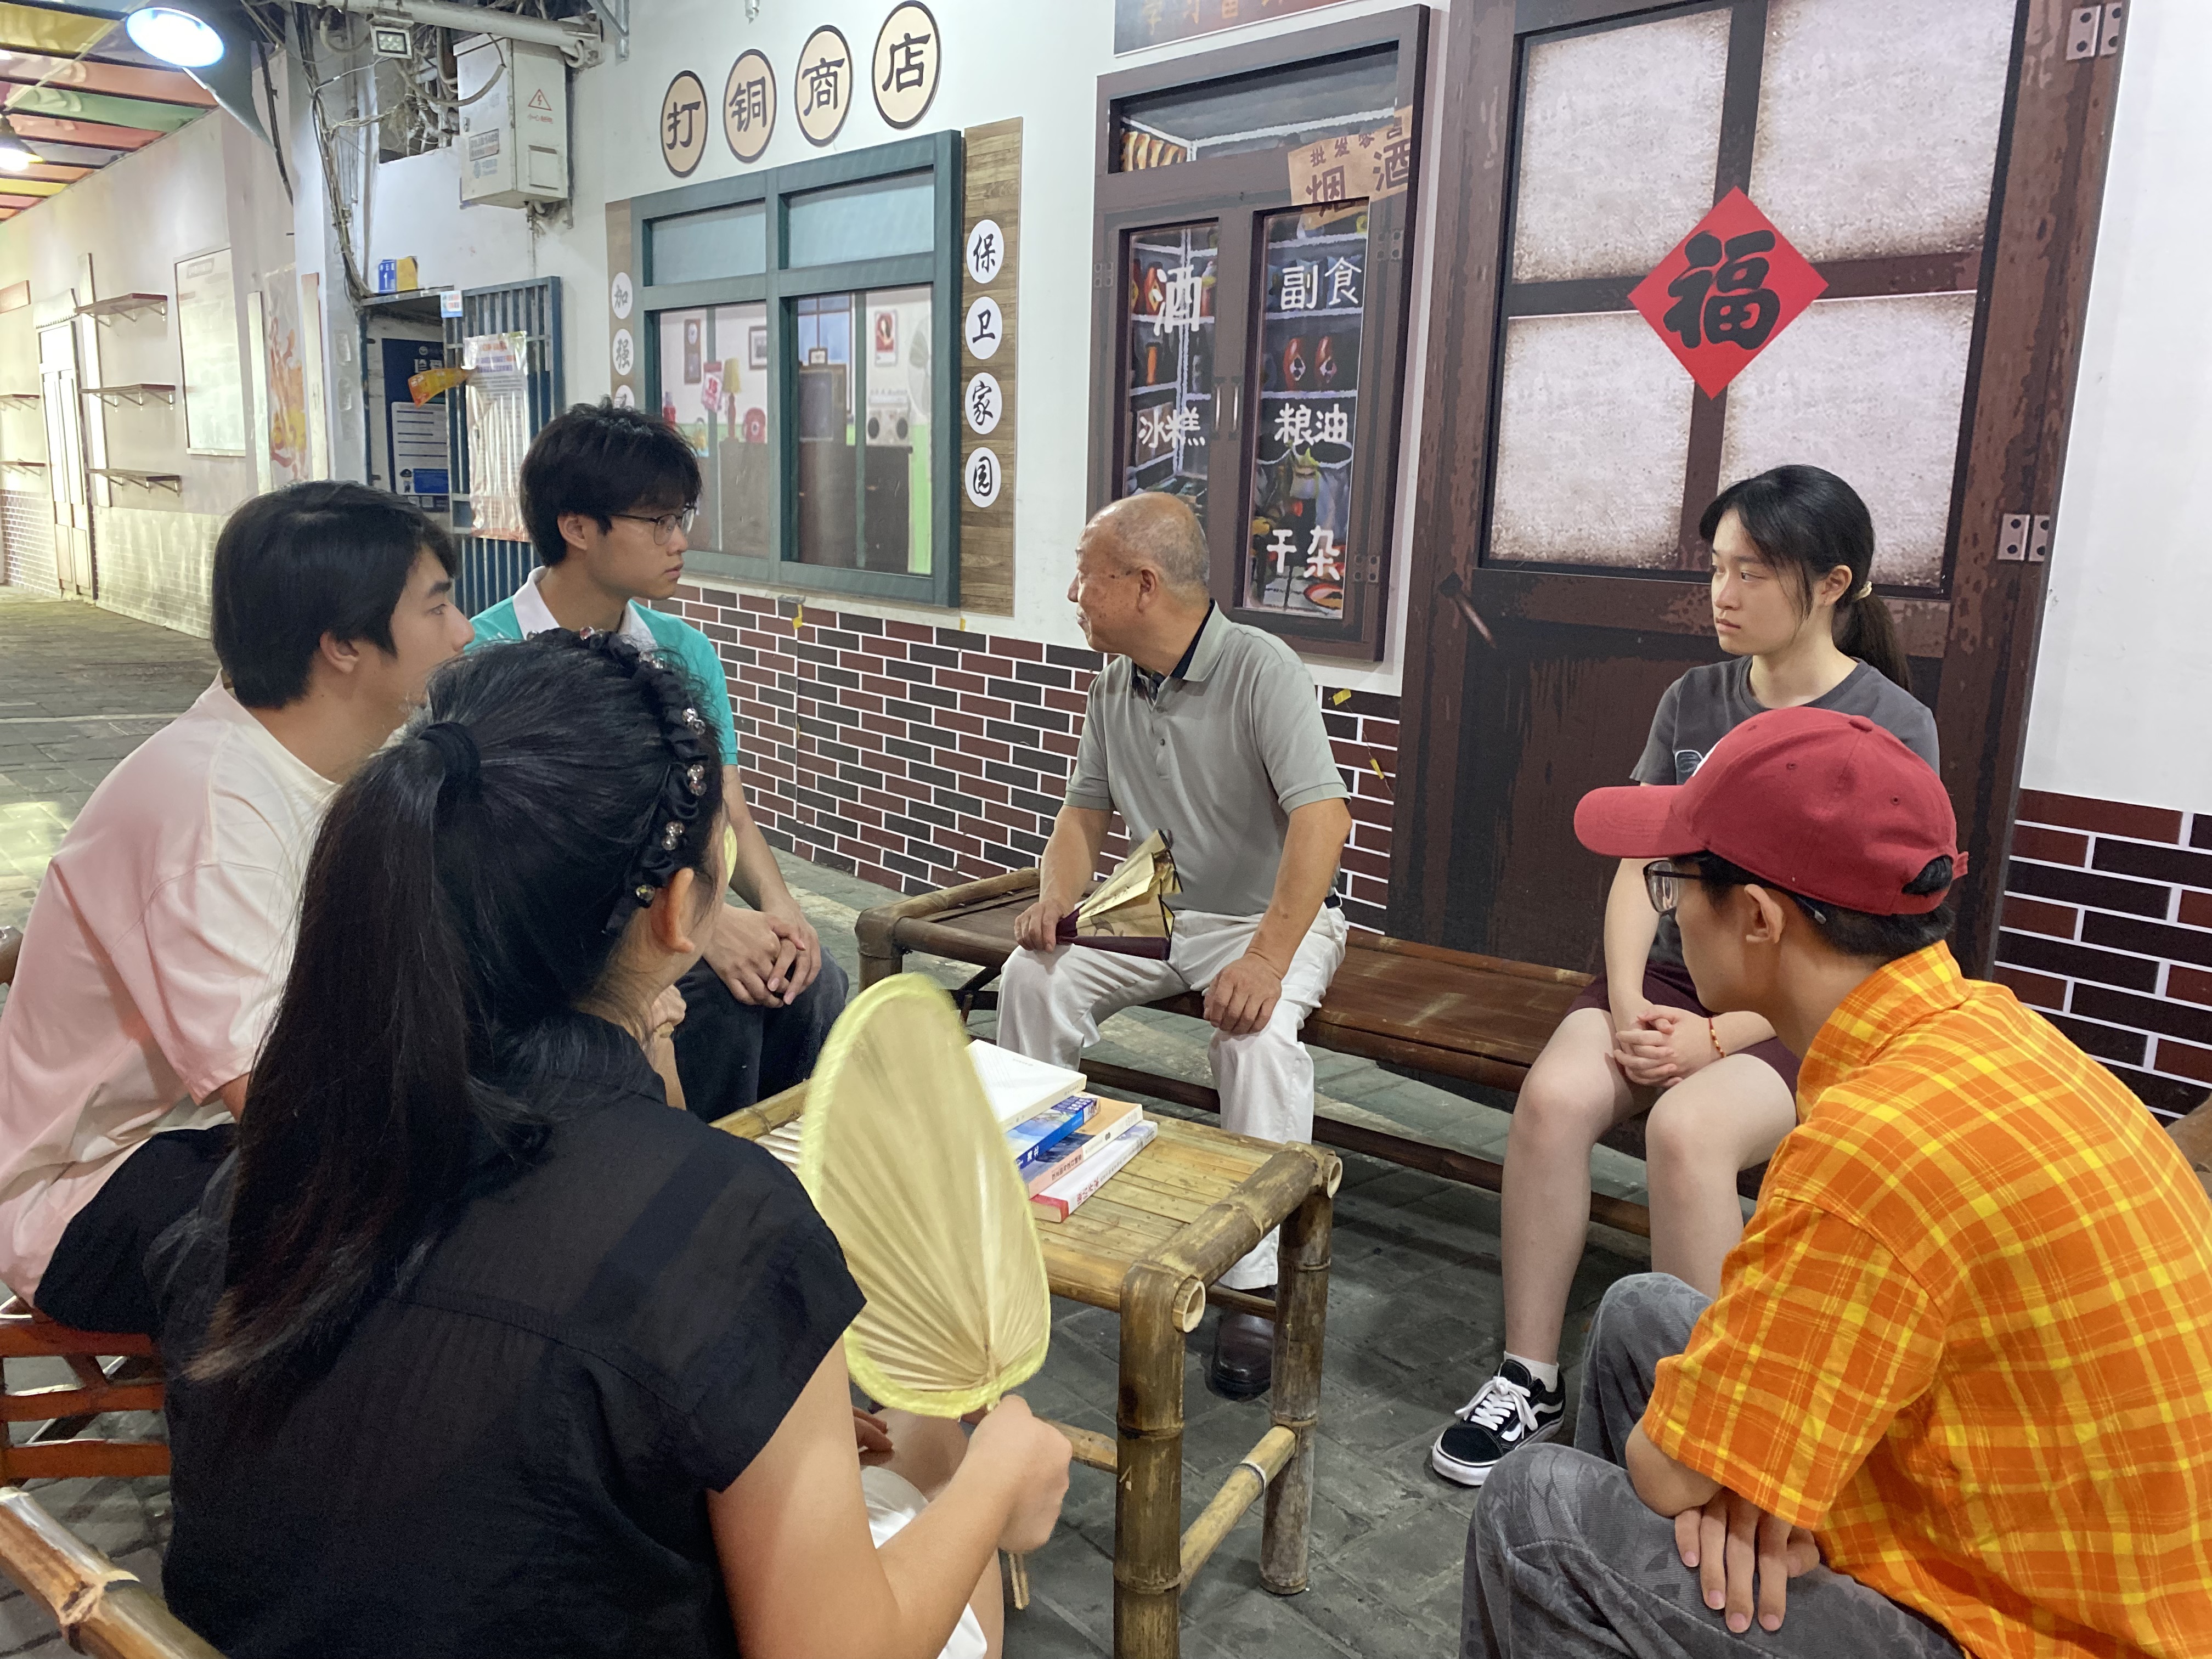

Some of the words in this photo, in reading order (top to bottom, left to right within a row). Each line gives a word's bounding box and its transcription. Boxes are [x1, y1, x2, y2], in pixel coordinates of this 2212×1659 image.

[665, 33, 931, 150] 打铜商店
[1305, 137, 1412, 217] 烟酒
[1152, 264, 1203, 336] 酒
[1280, 257, 1362, 310] 副食
[1663, 229, 1781, 351] 福
[972, 234, 996, 498] 保卫家园
[1138, 407, 1205, 449] 冰糕
[1273, 403, 1347, 446] 粮油
[1266, 525, 1340, 581] 干杂
